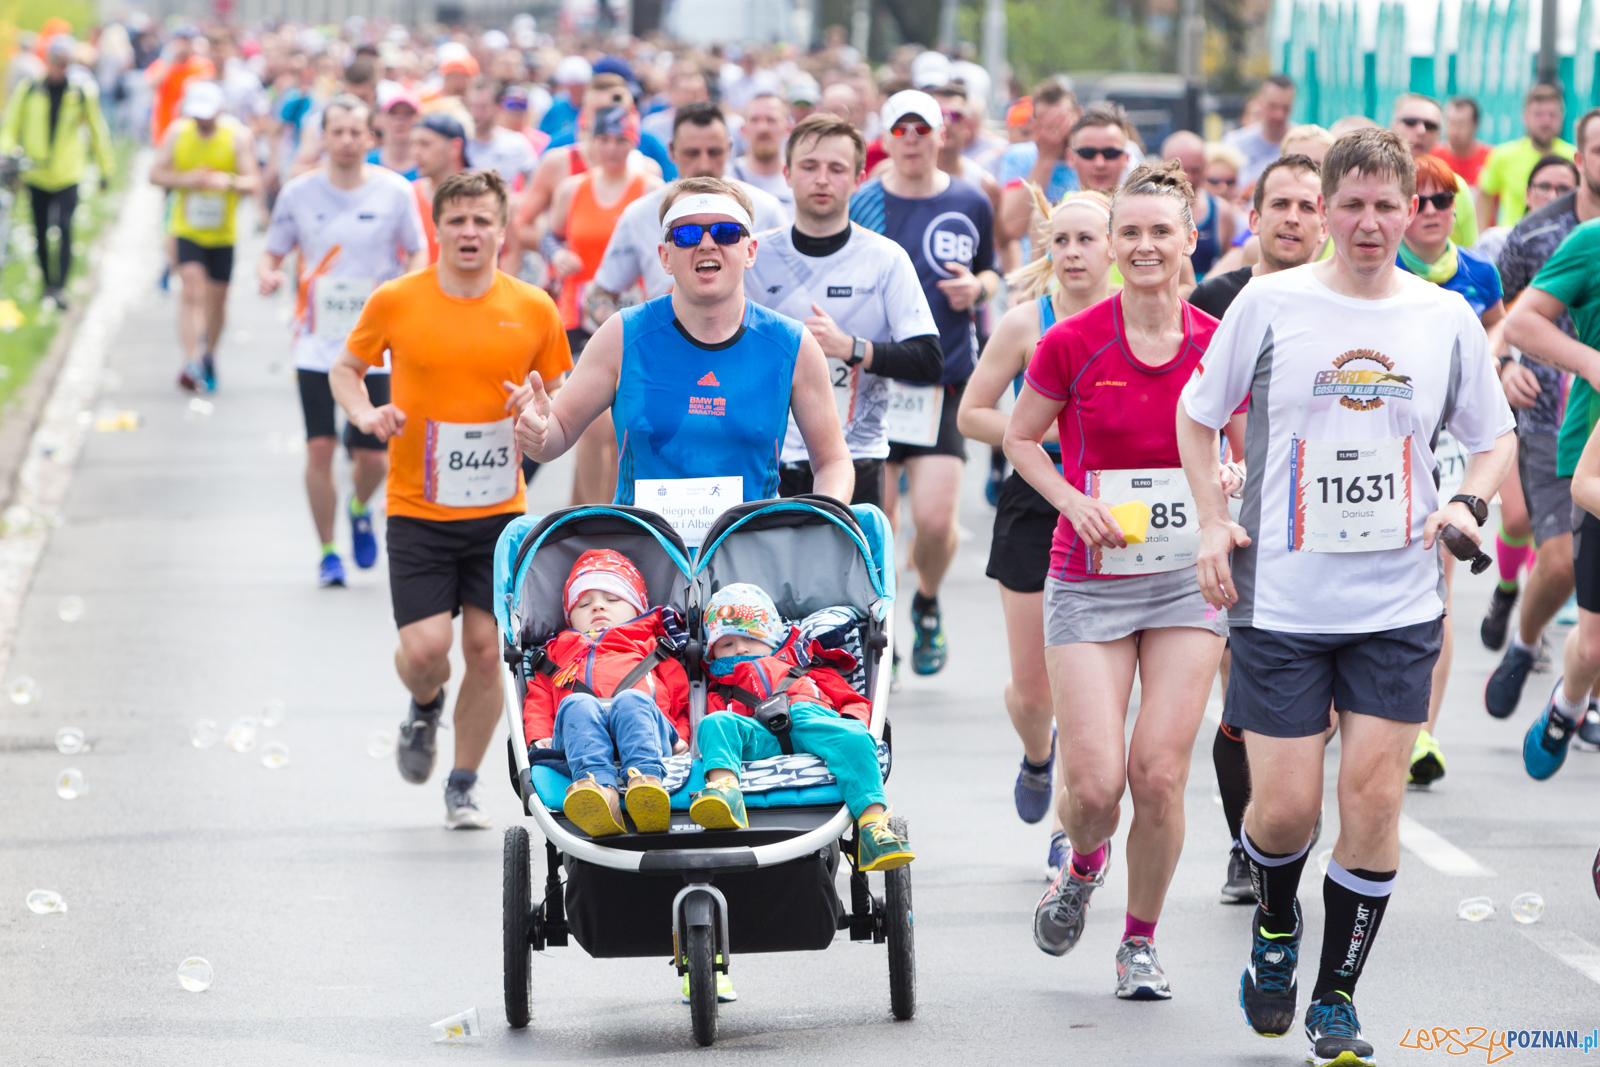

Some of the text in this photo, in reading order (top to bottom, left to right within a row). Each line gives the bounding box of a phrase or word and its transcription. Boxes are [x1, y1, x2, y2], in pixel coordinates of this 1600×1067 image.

[1332, 348, 1395, 371] MUROWANA
[1354, 385, 1375, 395] KLUB
[1375, 386, 1413, 399] BIEGACZA
[689, 396, 712, 405] BMW
[688, 408, 726, 416] MARATHON
[449, 446, 509, 470] 8443
[1317, 473, 1395, 503] 11631
[662, 506, 714, 517] biegnę dla
[1150, 502, 1187, 529] 85
[1342, 510, 1375, 518] Dariusz
[1145, 535, 1169, 543] atalia
